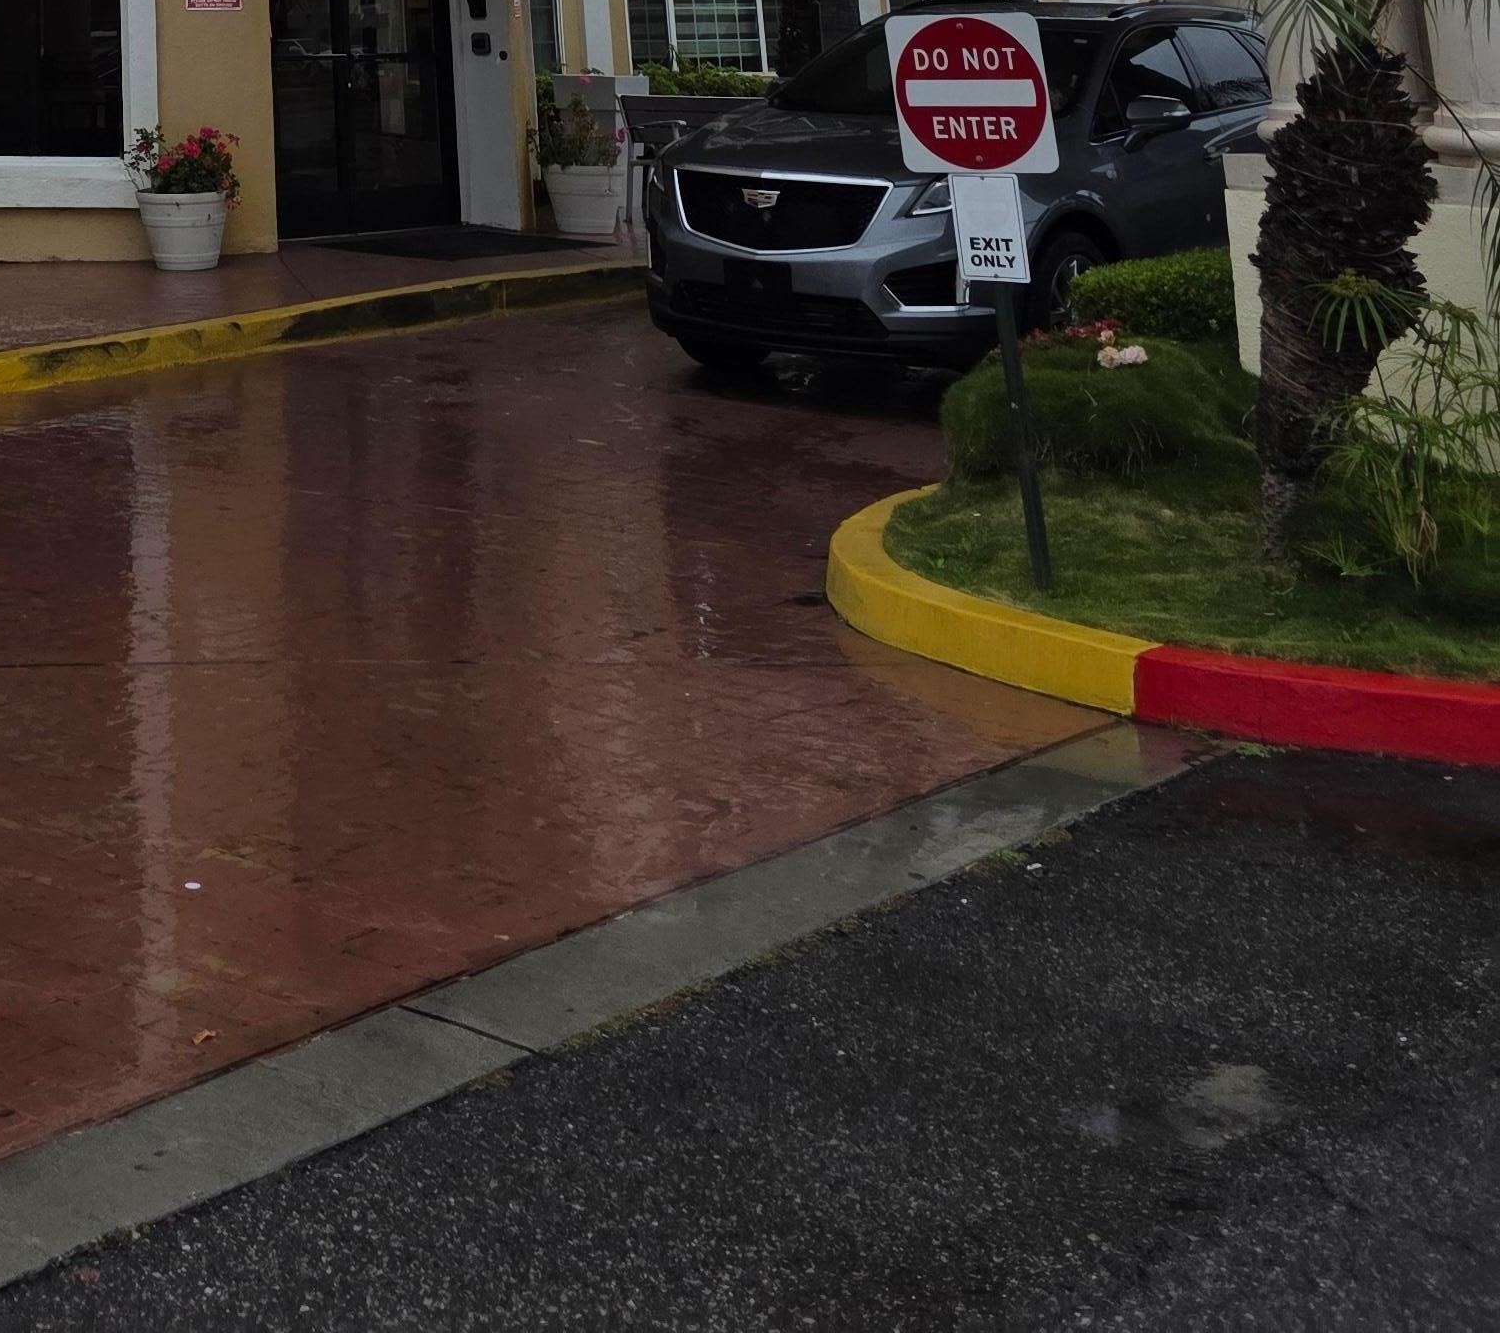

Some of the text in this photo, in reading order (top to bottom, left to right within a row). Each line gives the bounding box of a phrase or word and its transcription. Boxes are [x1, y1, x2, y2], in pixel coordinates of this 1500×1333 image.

[913, 48, 1016, 71] DO NOT
[932, 116, 1018, 140] ENTER
[969, 237, 1014, 252] EXIT
[970, 254, 1016, 269] ONLY
